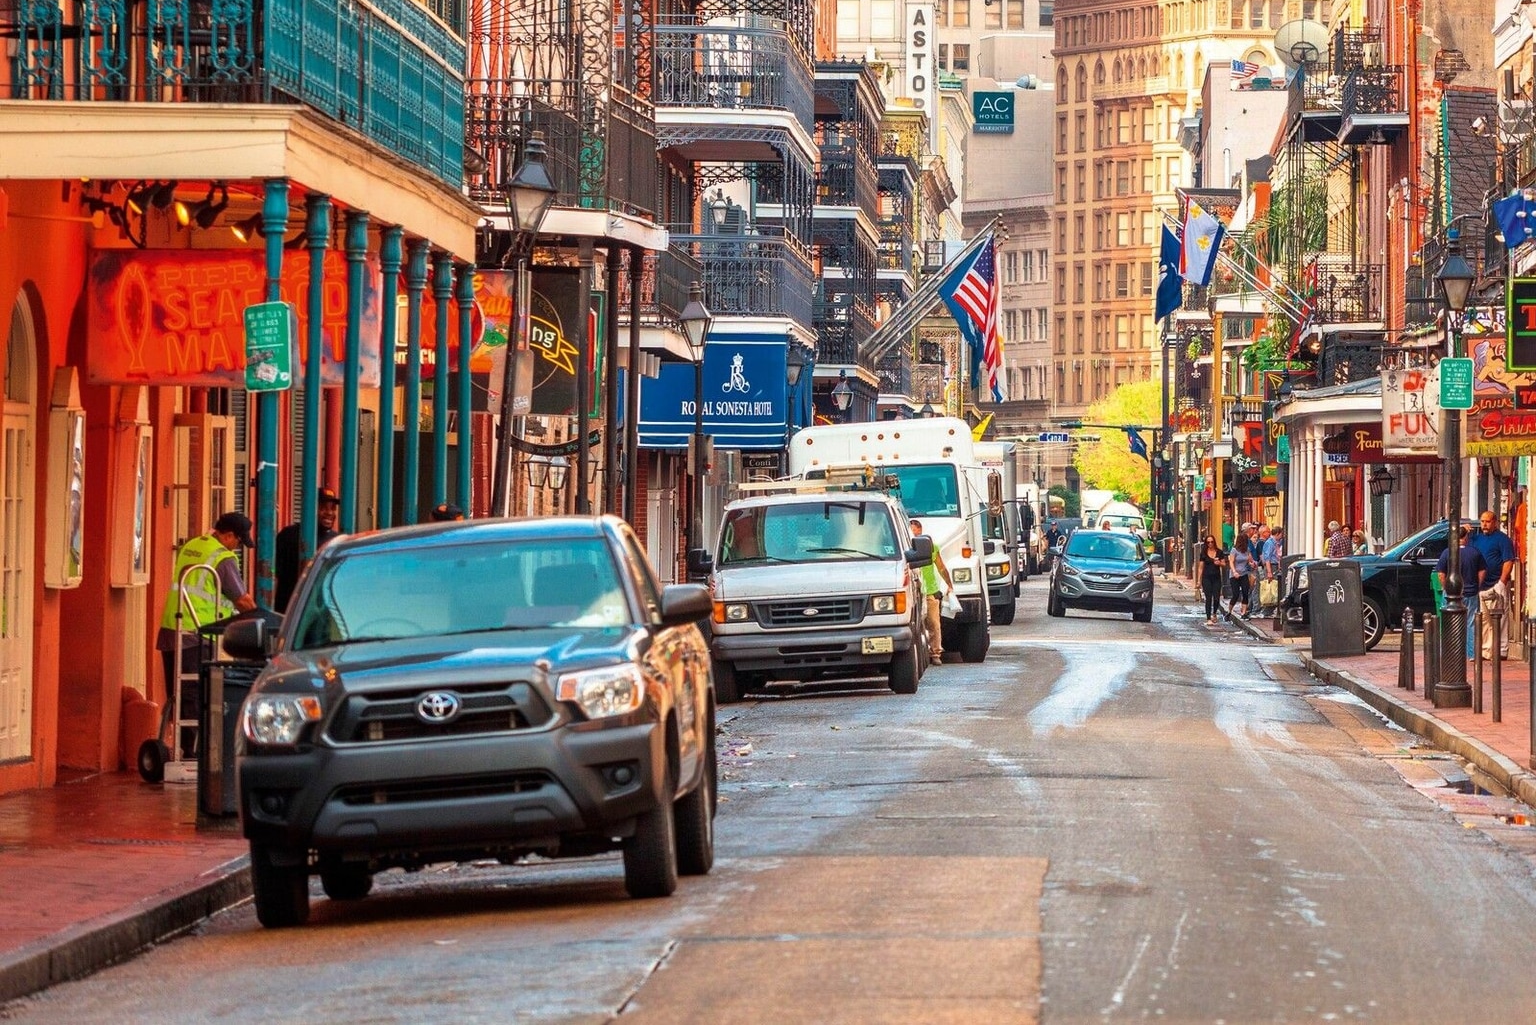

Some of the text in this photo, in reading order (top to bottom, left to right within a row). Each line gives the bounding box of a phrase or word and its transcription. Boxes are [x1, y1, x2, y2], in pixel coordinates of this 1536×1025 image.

[980, 97, 1008, 112] AC
[159, 263, 257, 289] PIER
[165, 321, 348, 374] MAT
[682, 401, 773, 416] ROAL SONESTA HOTEL
[749, 458, 771, 467] Conti
